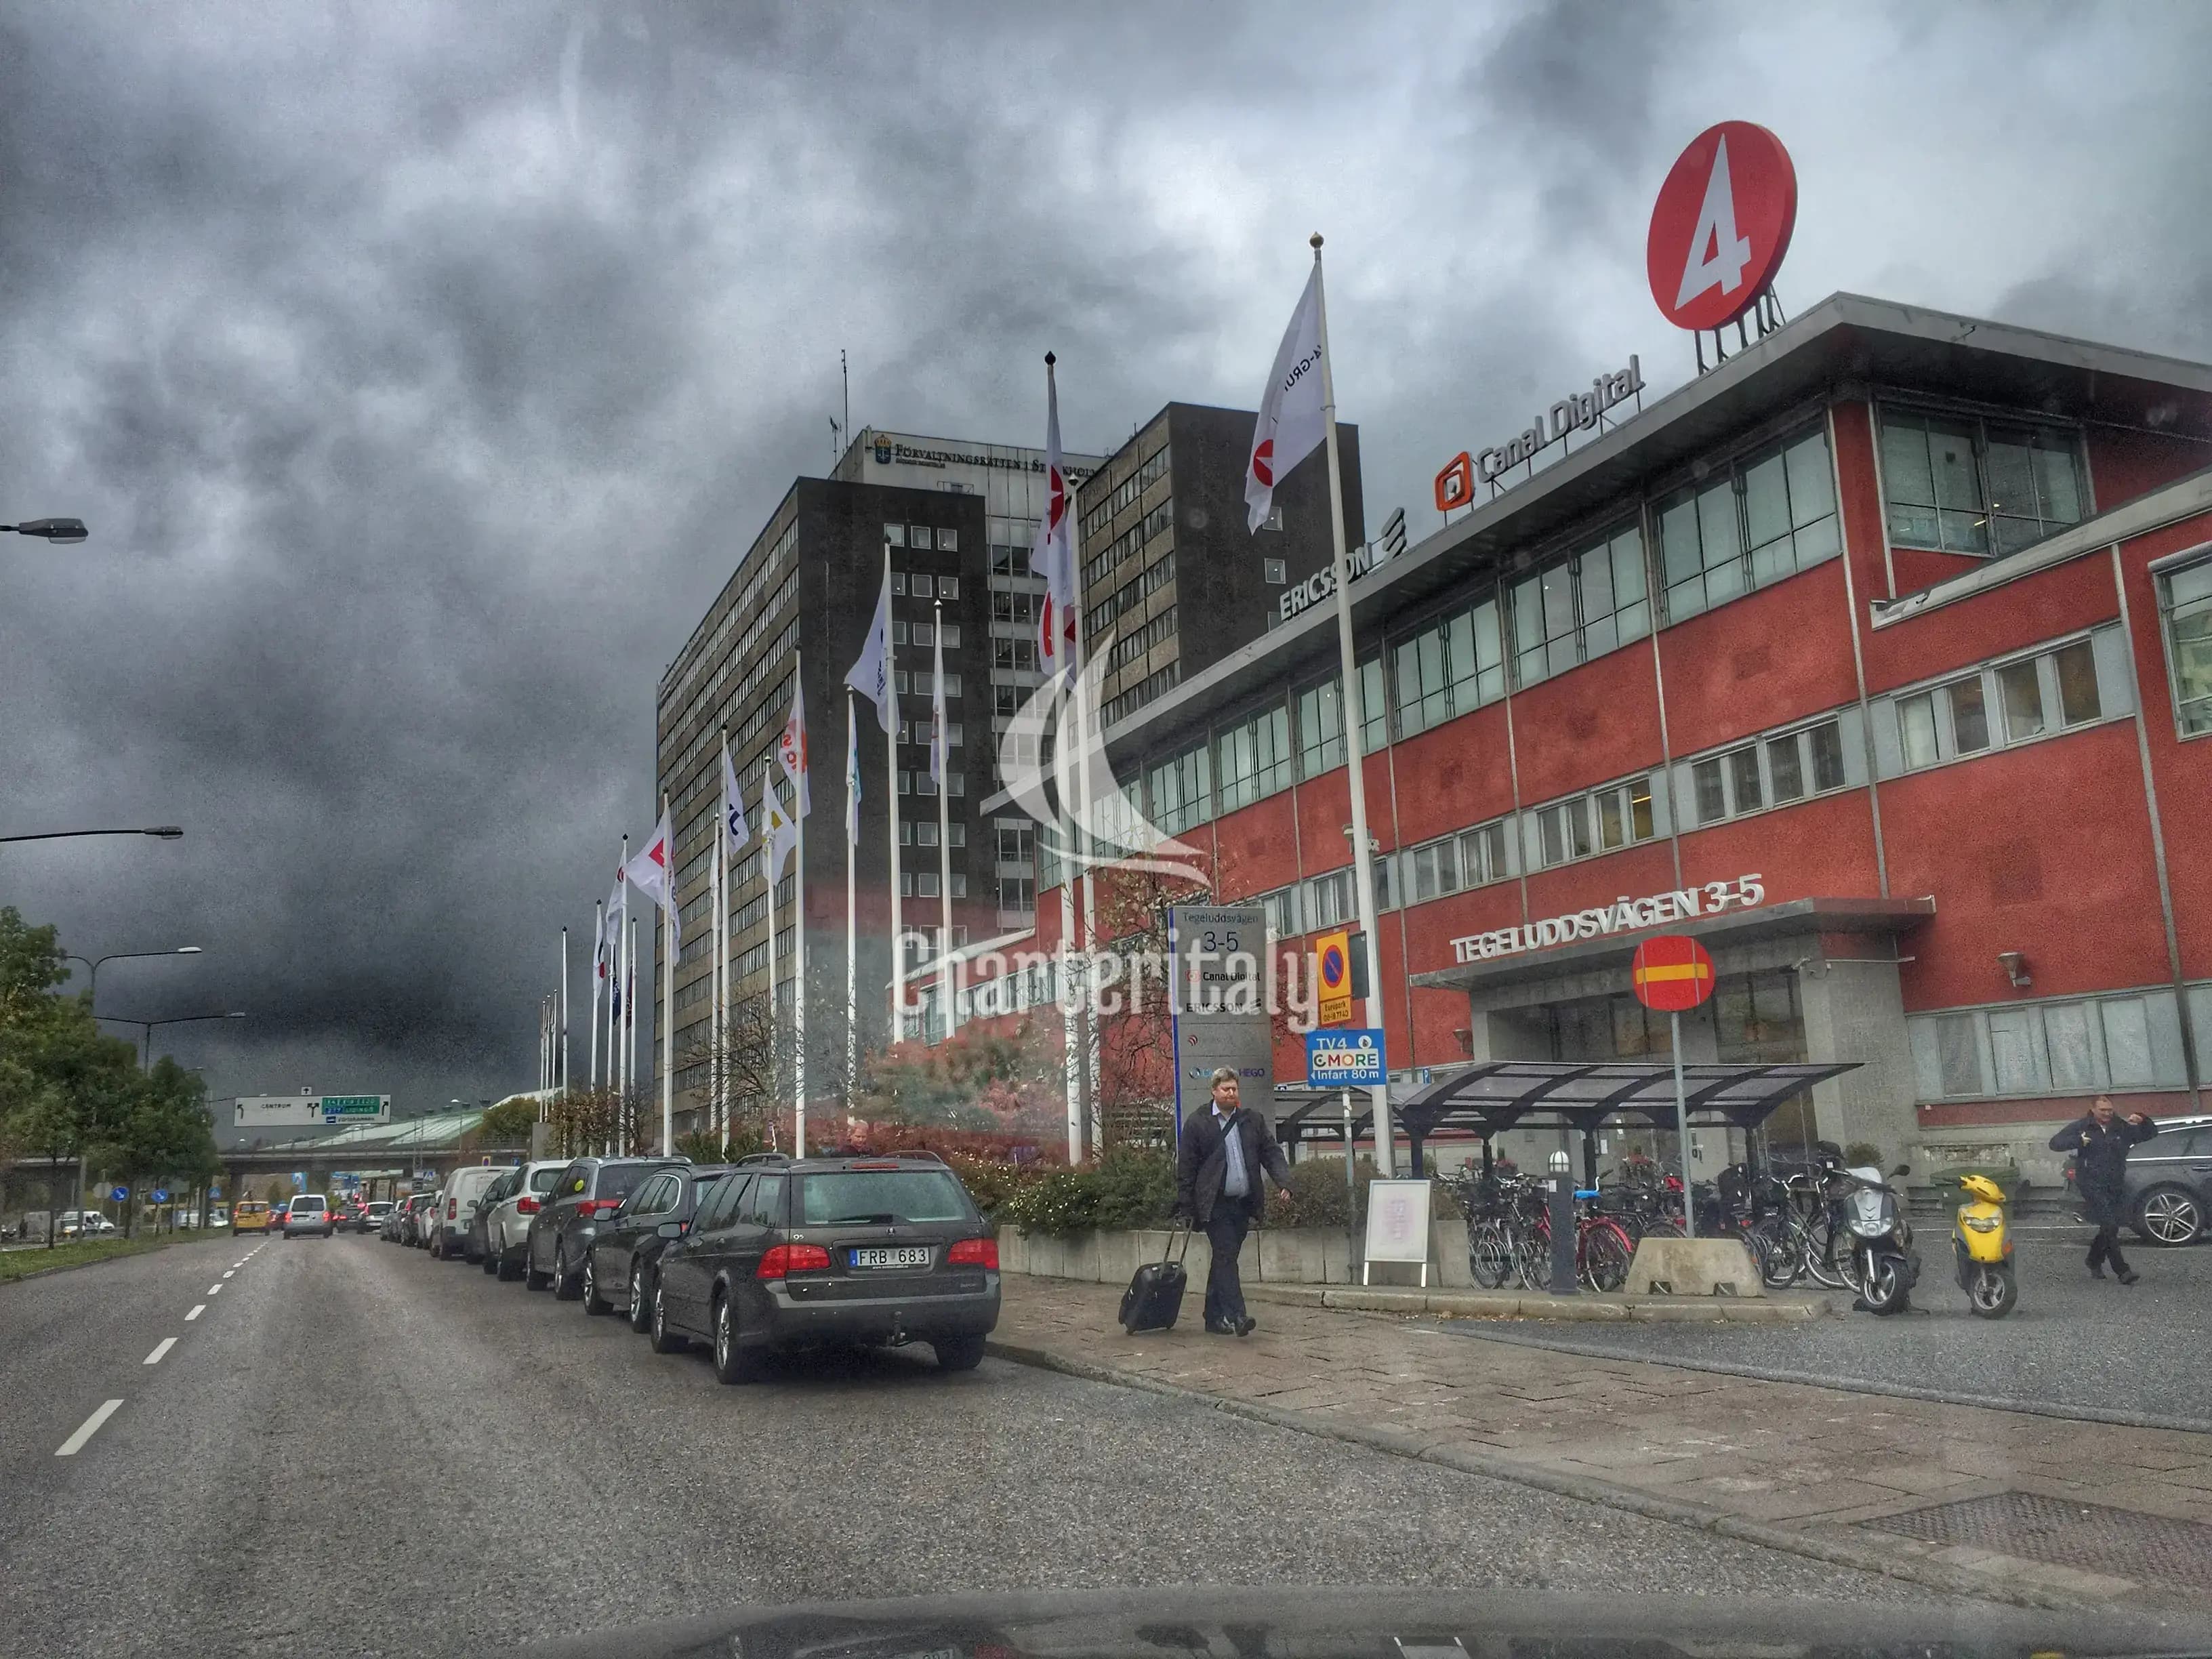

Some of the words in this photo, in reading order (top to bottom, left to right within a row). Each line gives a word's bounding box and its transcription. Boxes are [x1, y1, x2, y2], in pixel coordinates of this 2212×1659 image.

[1675, 133, 1751, 310] 4
[1477, 415, 1551, 483] Canal
[1549, 354, 1647, 437] Digital
[1449, 887, 1701, 964] TEGELUDDSVÄGEN
[1705, 874, 1764, 913] 3-5
[1204, 931, 1238, 951] 3-5
[1203, 972, 1229, 981] Canal
[1187, 1003, 1243, 1012] ERICSSON
[1239, 1069, 1265, 1077] HEGO
[1318, 1070, 1348, 1080] Infart
[1351, 1069, 1367, 1079] 80
[859, 1250, 887, 1265] FRB
[899, 1249, 926, 1263] 683
